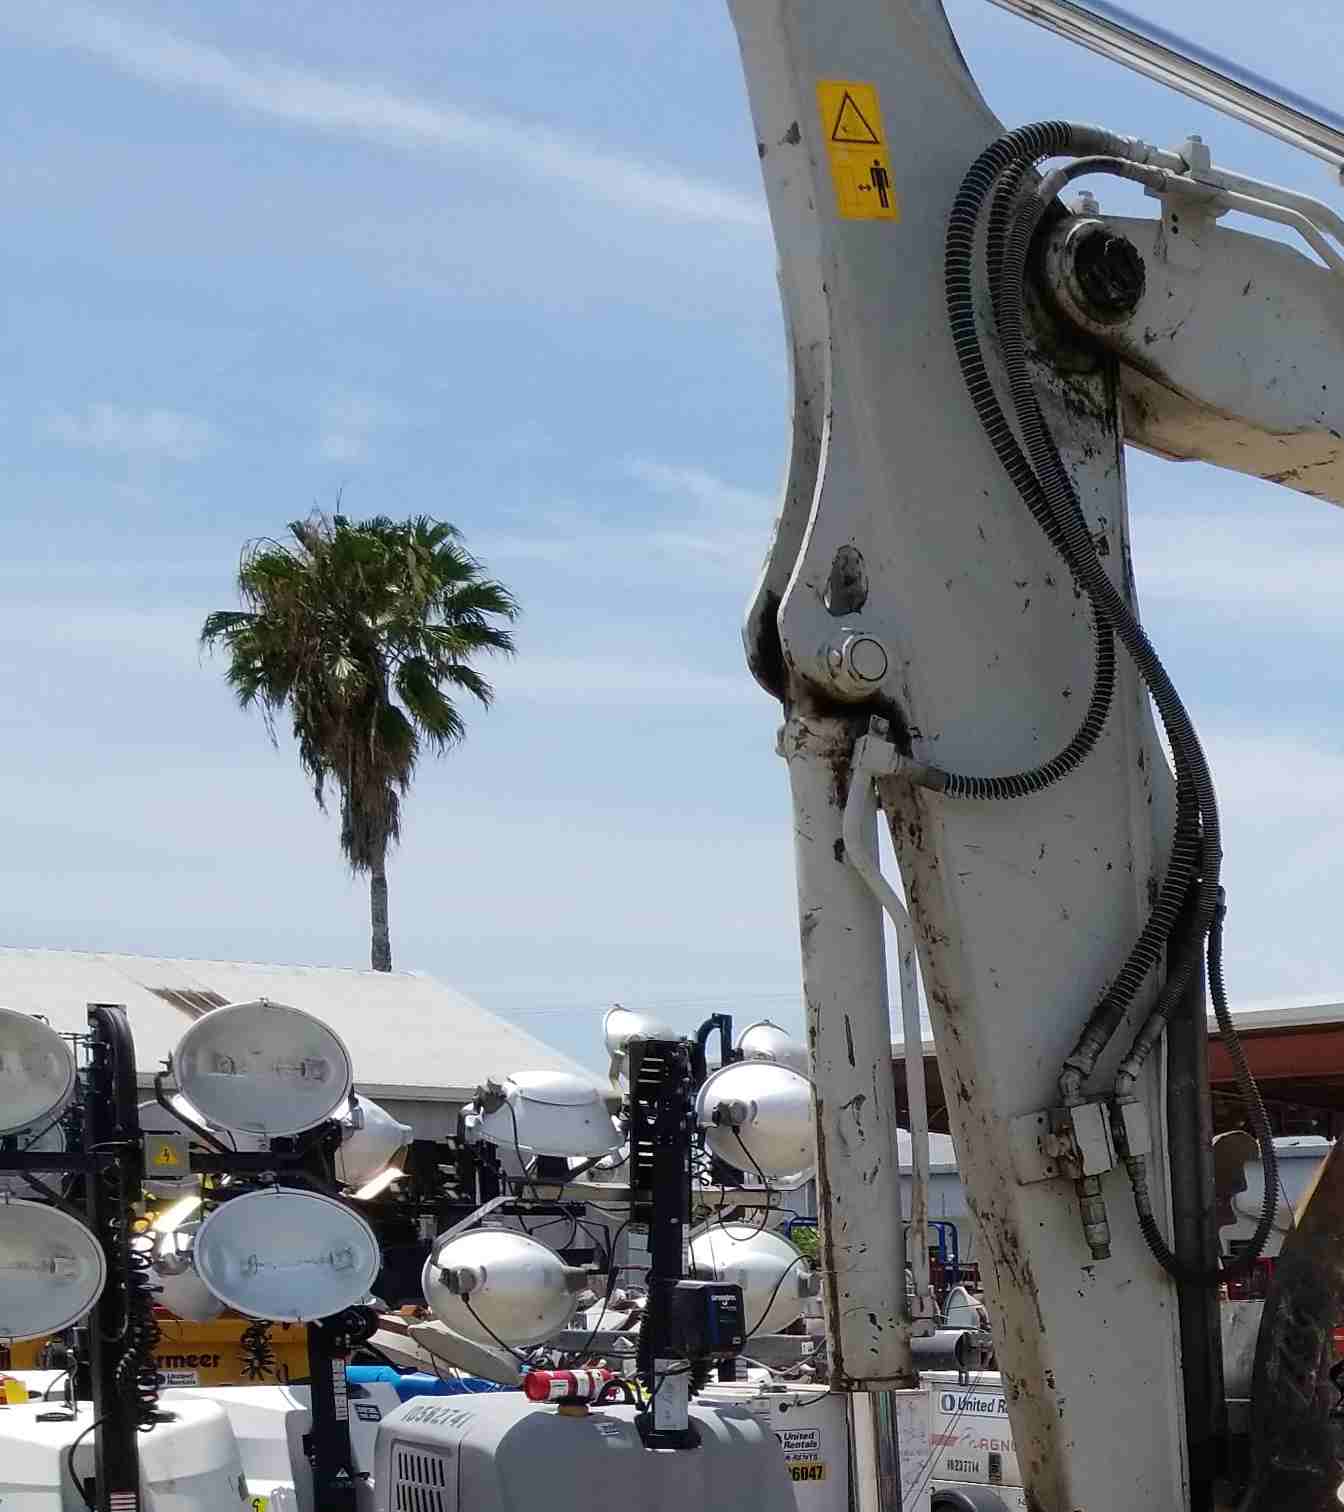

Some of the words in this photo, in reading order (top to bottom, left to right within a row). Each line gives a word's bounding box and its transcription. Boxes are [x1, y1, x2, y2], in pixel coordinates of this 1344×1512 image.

[157, 1353, 221, 1368] rmeer
[958, 1397, 996, 1413] United
[784, 1431, 815, 1441] United
[784, 1440, 818, 1449] Rentals
[789, 1465, 823, 1481] 6047
